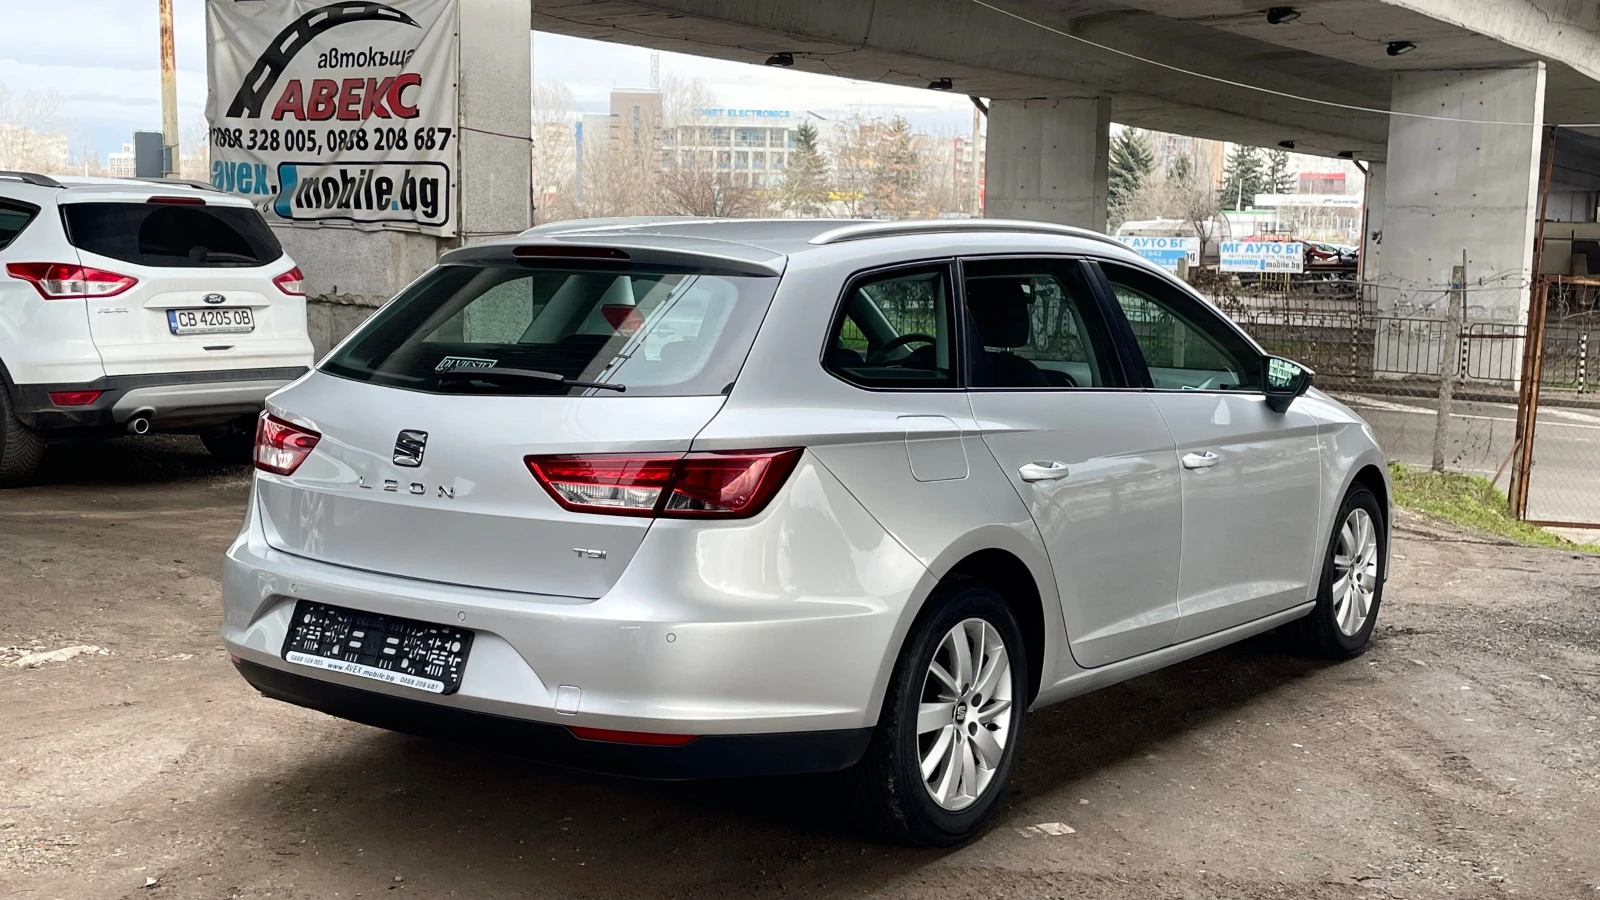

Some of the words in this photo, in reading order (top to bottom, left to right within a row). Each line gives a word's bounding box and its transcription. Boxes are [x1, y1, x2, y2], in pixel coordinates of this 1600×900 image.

[271, 73, 422, 121] АВЕКС
[728, 109, 790, 117] ELECTRONICS
[247, 129, 280, 151] 328
[284, 129, 322, 155] 005,
[374, 127, 408, 150] 208
[414, 127, 452, 150] 687
[1132, 238, 1166, 248] АУТО
[1170, 238, 1186, 248] БГ
[1222, 243, 1242, 253] МГ
[1245, 244, 1282, 254] АУТО
[1286, 244, 1302, 254] БГ
[1266, 261, 1300, 270] mobile.bg
[200, 311, 232, 326] 4205
[359, 475, 456, 499] LEON
